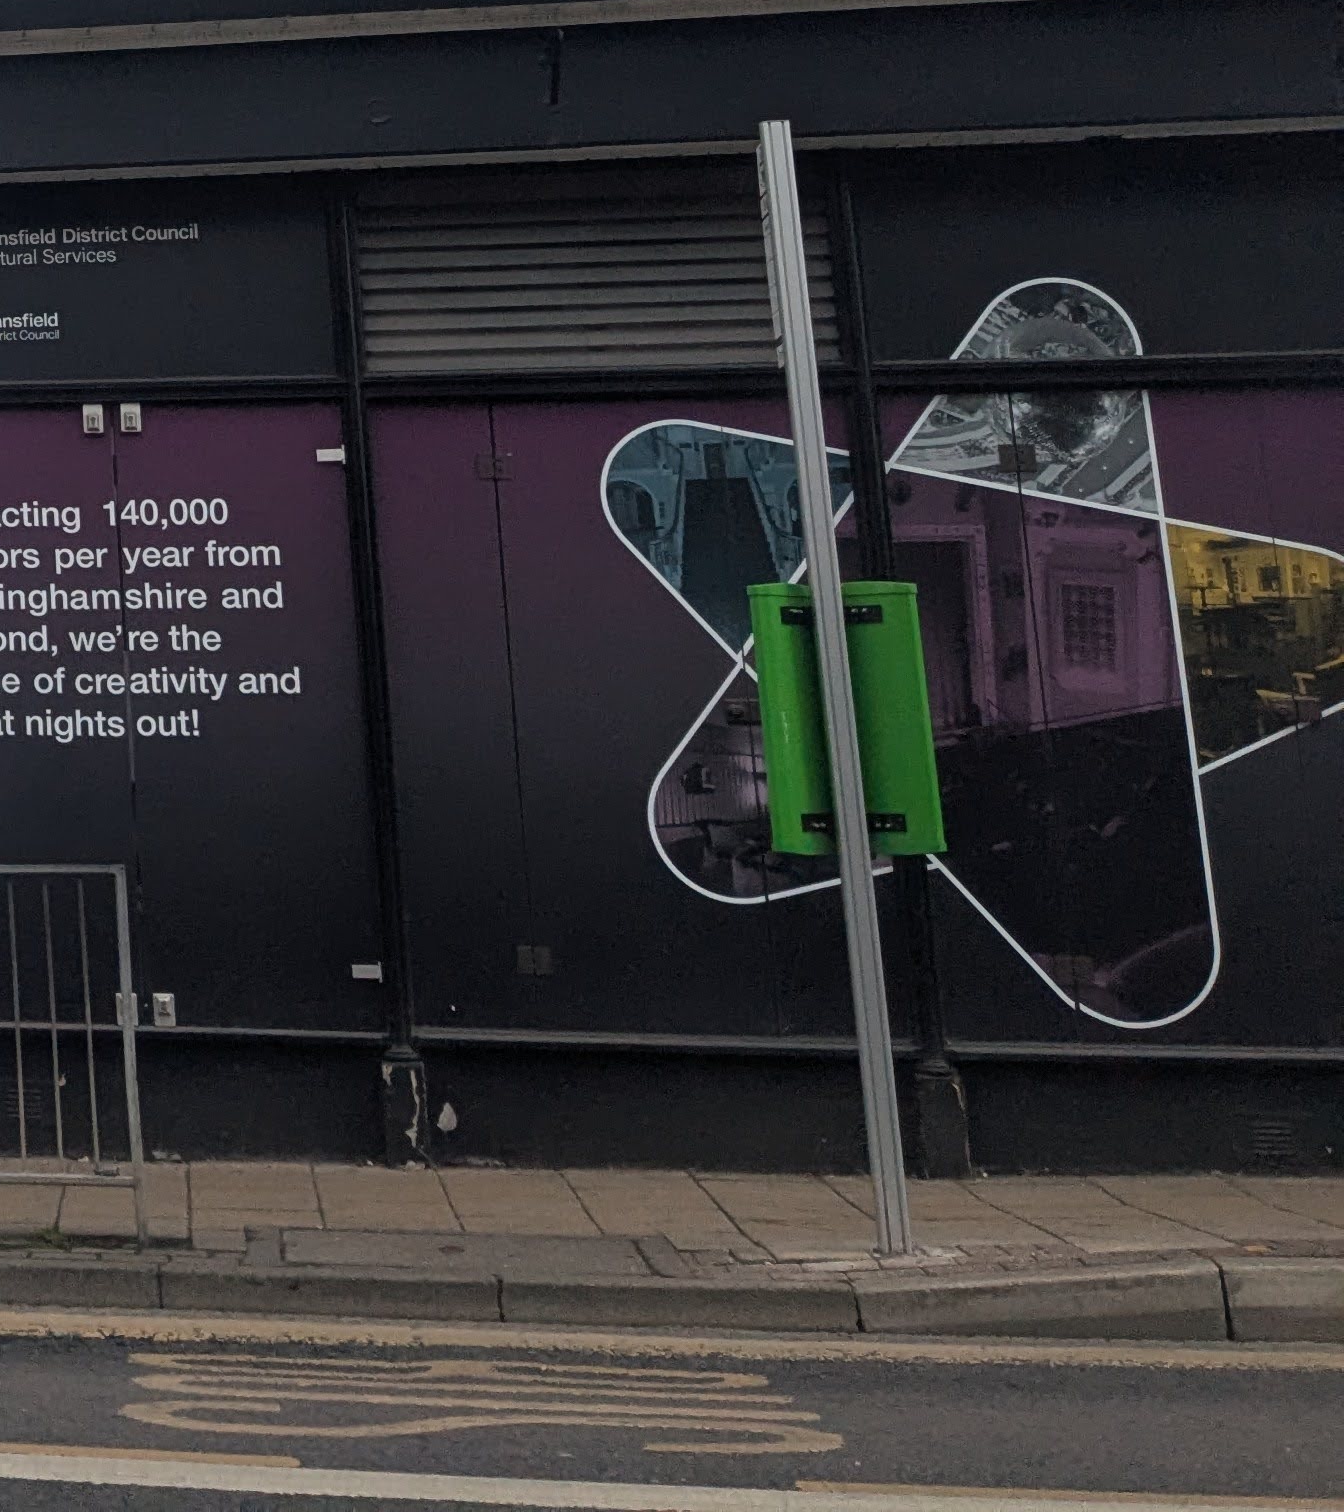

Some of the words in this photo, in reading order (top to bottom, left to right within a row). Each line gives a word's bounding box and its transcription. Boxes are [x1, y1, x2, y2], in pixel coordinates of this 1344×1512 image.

[62, 226, 128, 244] District
[131, 224, 199, 242] Council
[42, 248, 116, 265] Services
[19, 329, 60, 341] Council
[103, 498, 228, 530] 140,000
[54, 546, 108, 574] per
[122, 544, 194, 573] year
[205, 540, 281, 567] from
[221, 581, 284, 609] and
[68, 624, 159, 652] we're
[168, 624, 222, 651] the
[33, 667, 66, 694] of
[75, 666, 227, 701] creativity
[238, 667, 300, 694] and
[25, 709, 125, 743] nights
[136, 709, 200, 737] out!
[115, 1354, 846, 1454] BUS
